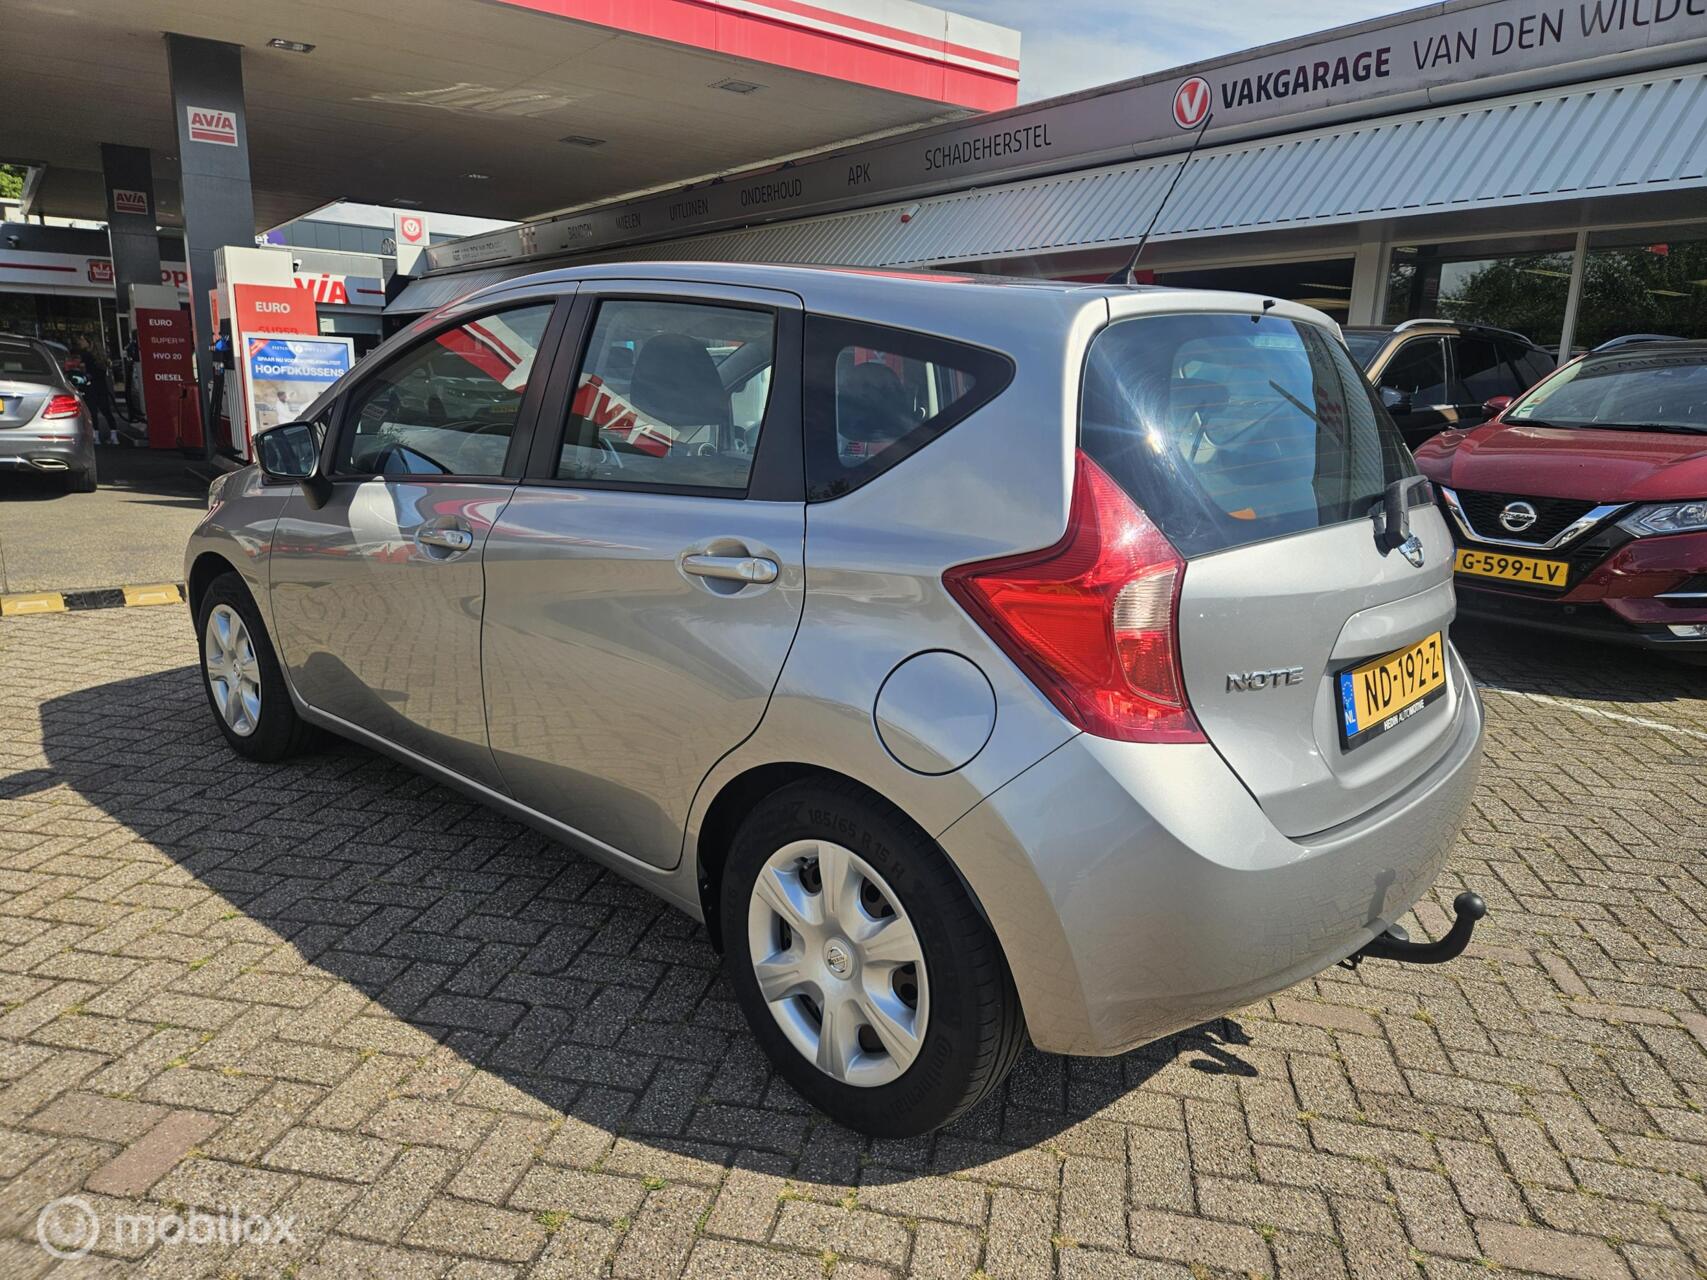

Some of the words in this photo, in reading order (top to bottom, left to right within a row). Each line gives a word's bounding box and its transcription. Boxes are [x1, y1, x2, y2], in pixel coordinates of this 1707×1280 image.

[1221, 47, 1390, 109] VAKGARAGE
[1413, 27, 1478, 70] VAN
[1492, 8, 1564, 56] DEN
[925, 124, 1051, 171] SCHADEHERSTEL
[848, 163, 871, 185] APK
[741, 180, 802, 206] ONDERHOUD
[255, 301, 291, 314] EURO
[149, 318, 173, 327] EURO
[154, 373, 184, 381] DIESEL
[255, 364, 345, 377] HOOFDKUSSENS
[1462, 553, 1560, 582] G-599-LV
[1225, 667, 1304, 694] NOTE
[1364, 641, 1439, 716] ND-192-Z
[1345, 710, 1356, 724] NL
